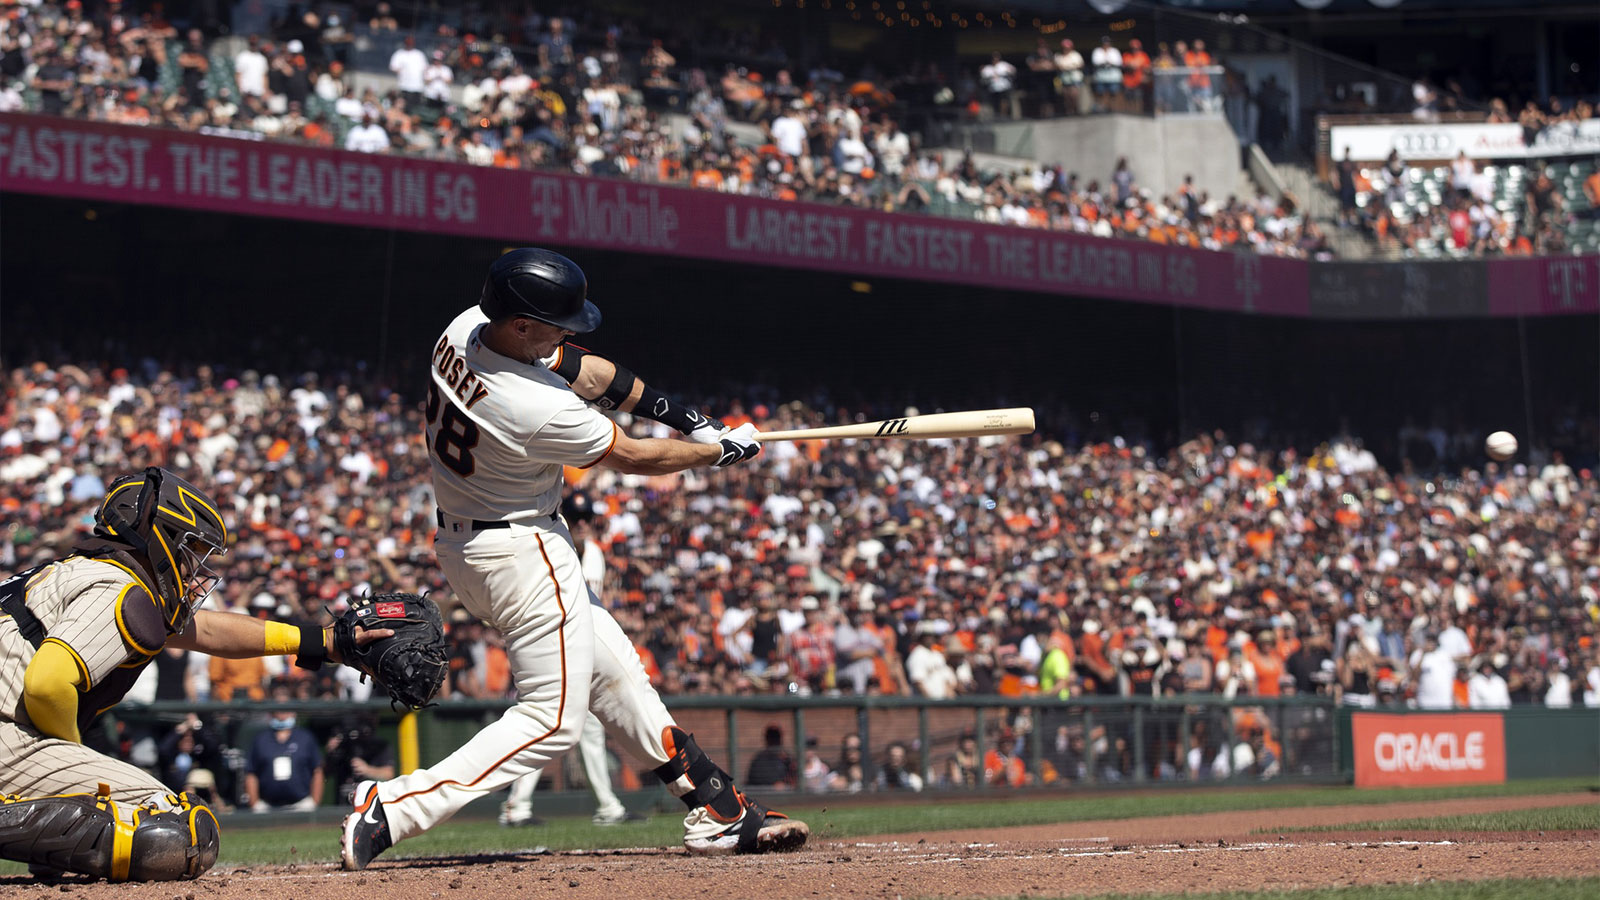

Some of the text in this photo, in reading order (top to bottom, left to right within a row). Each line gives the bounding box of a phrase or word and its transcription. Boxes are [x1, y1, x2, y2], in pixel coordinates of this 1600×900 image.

[168, 143, 241, 199] THE
[248, 152, 384, 215] LEADER
[391, 167, 426, 218] IN
[433, 171, 477, 222] 5G
[567, 179, 680, 249] Mobile
[726, 204, 1198, 297] LARGEST. FASTEST. THE LEADER IN 5G
[432, 334, 489, 411] POSEY
[1374, 731, 1486, 772] ORACLE
